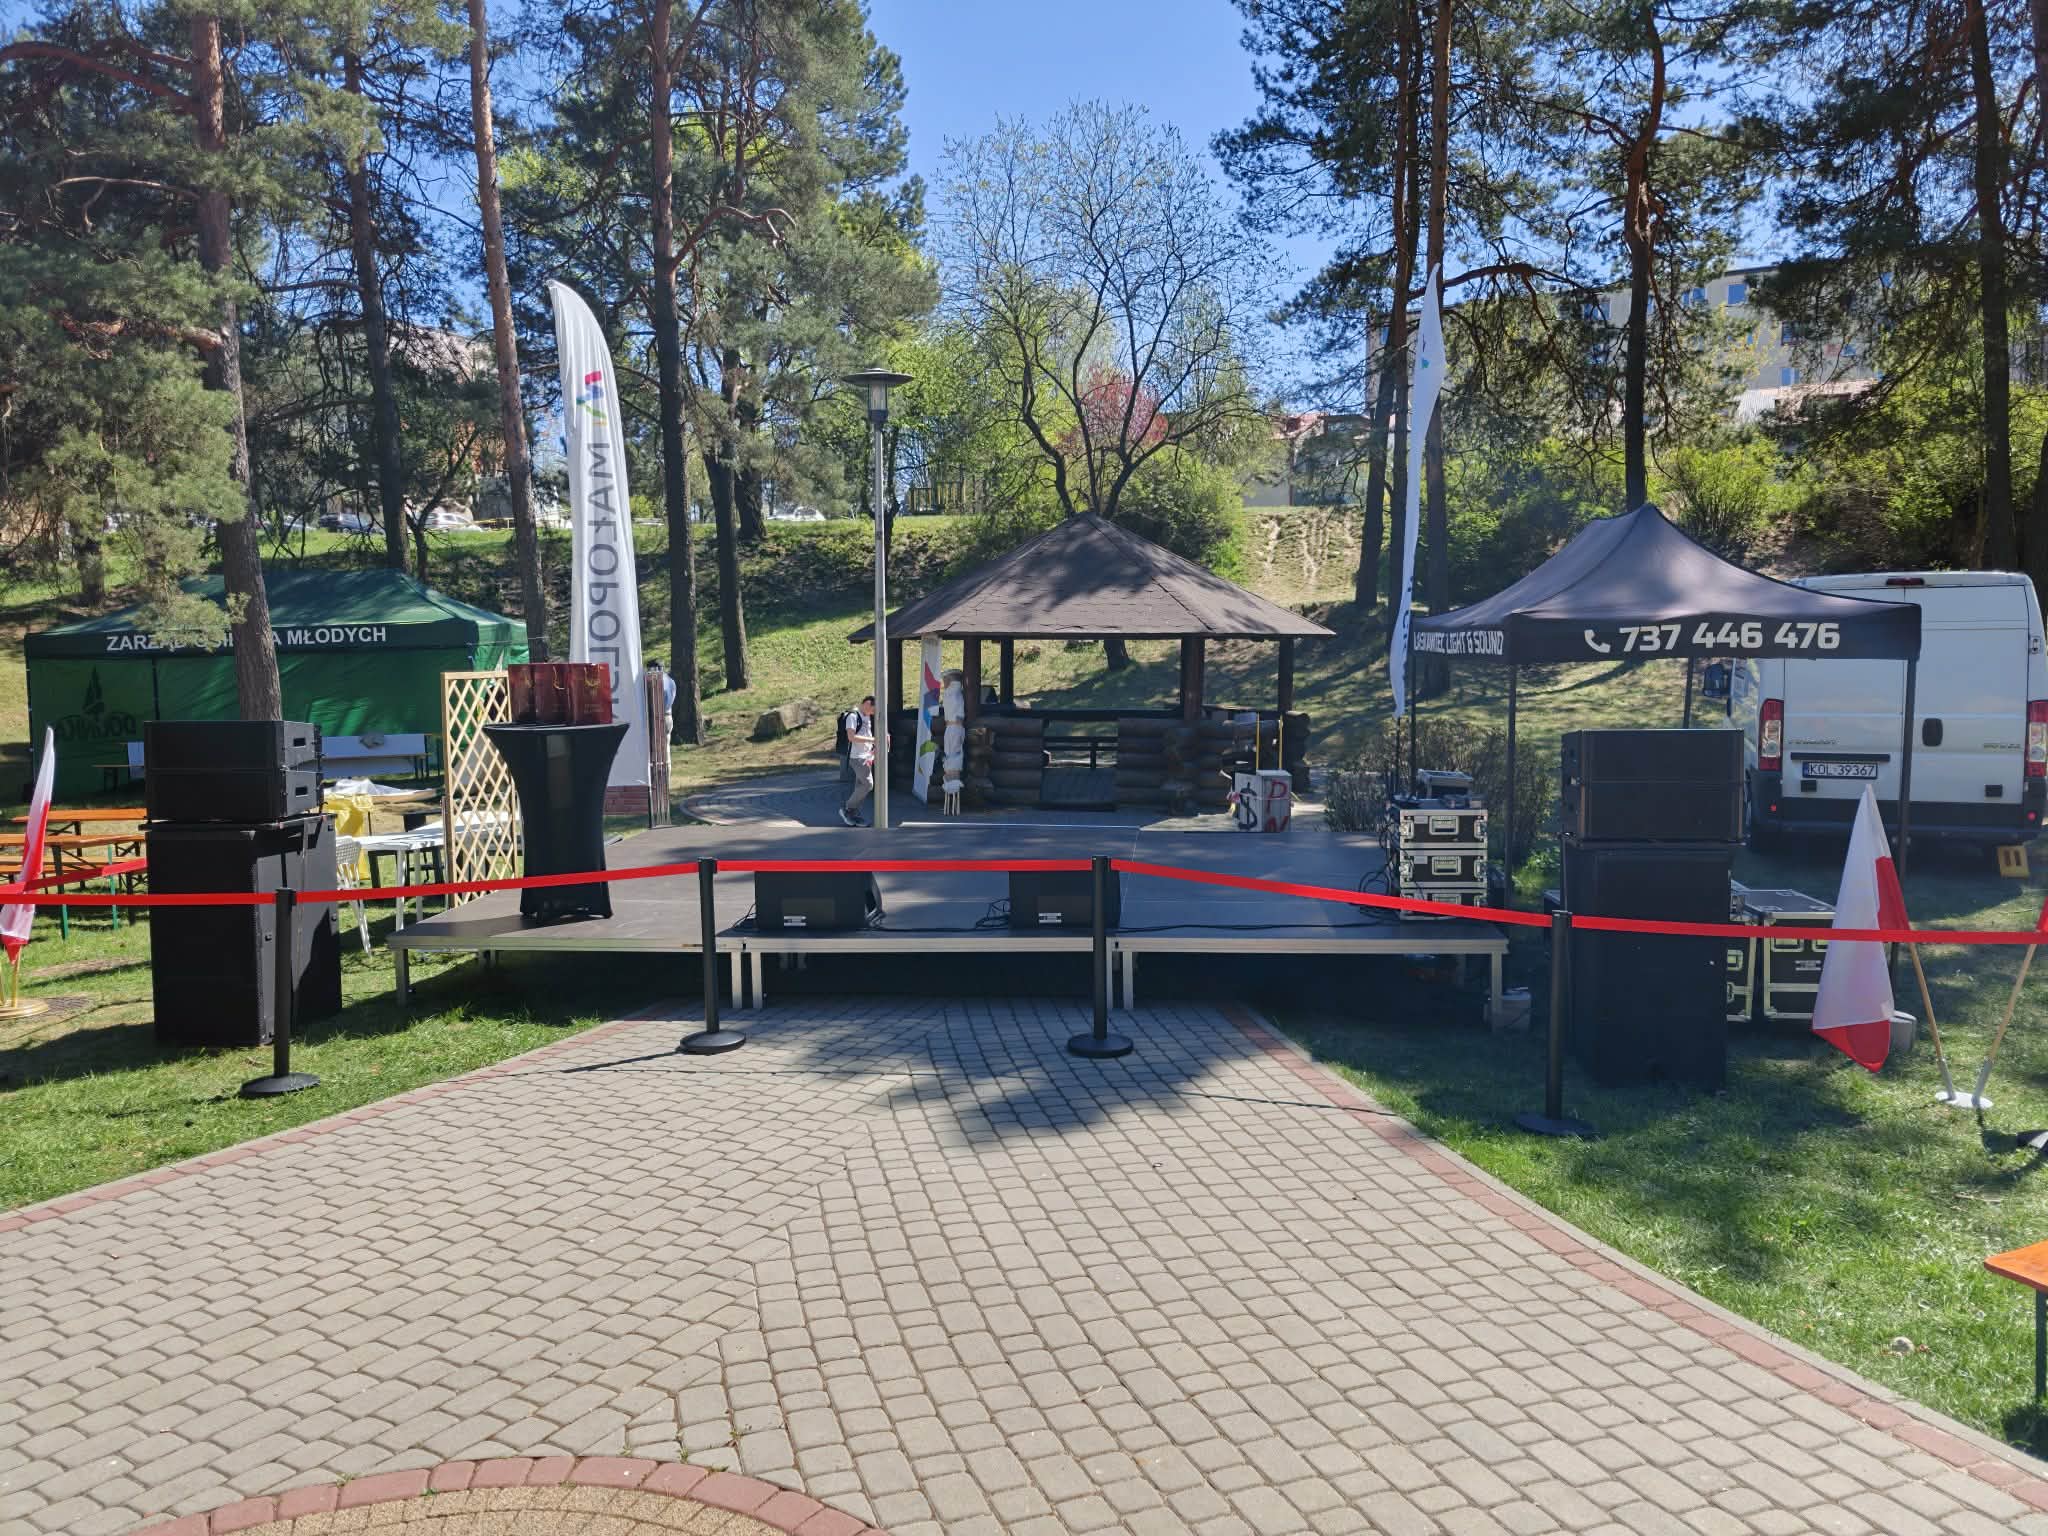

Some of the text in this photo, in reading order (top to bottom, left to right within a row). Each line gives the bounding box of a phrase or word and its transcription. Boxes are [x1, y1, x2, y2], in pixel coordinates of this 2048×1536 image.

[287, 627, 387, 645] MŁODYCH
[1446, 632, 1466, 654] LIGHT
[1473, 630, 1504, 655] SOUND
[1619, 622, 1840, 652] 737 446 476
[1810, 763, 1875, 777] KOL 39367
